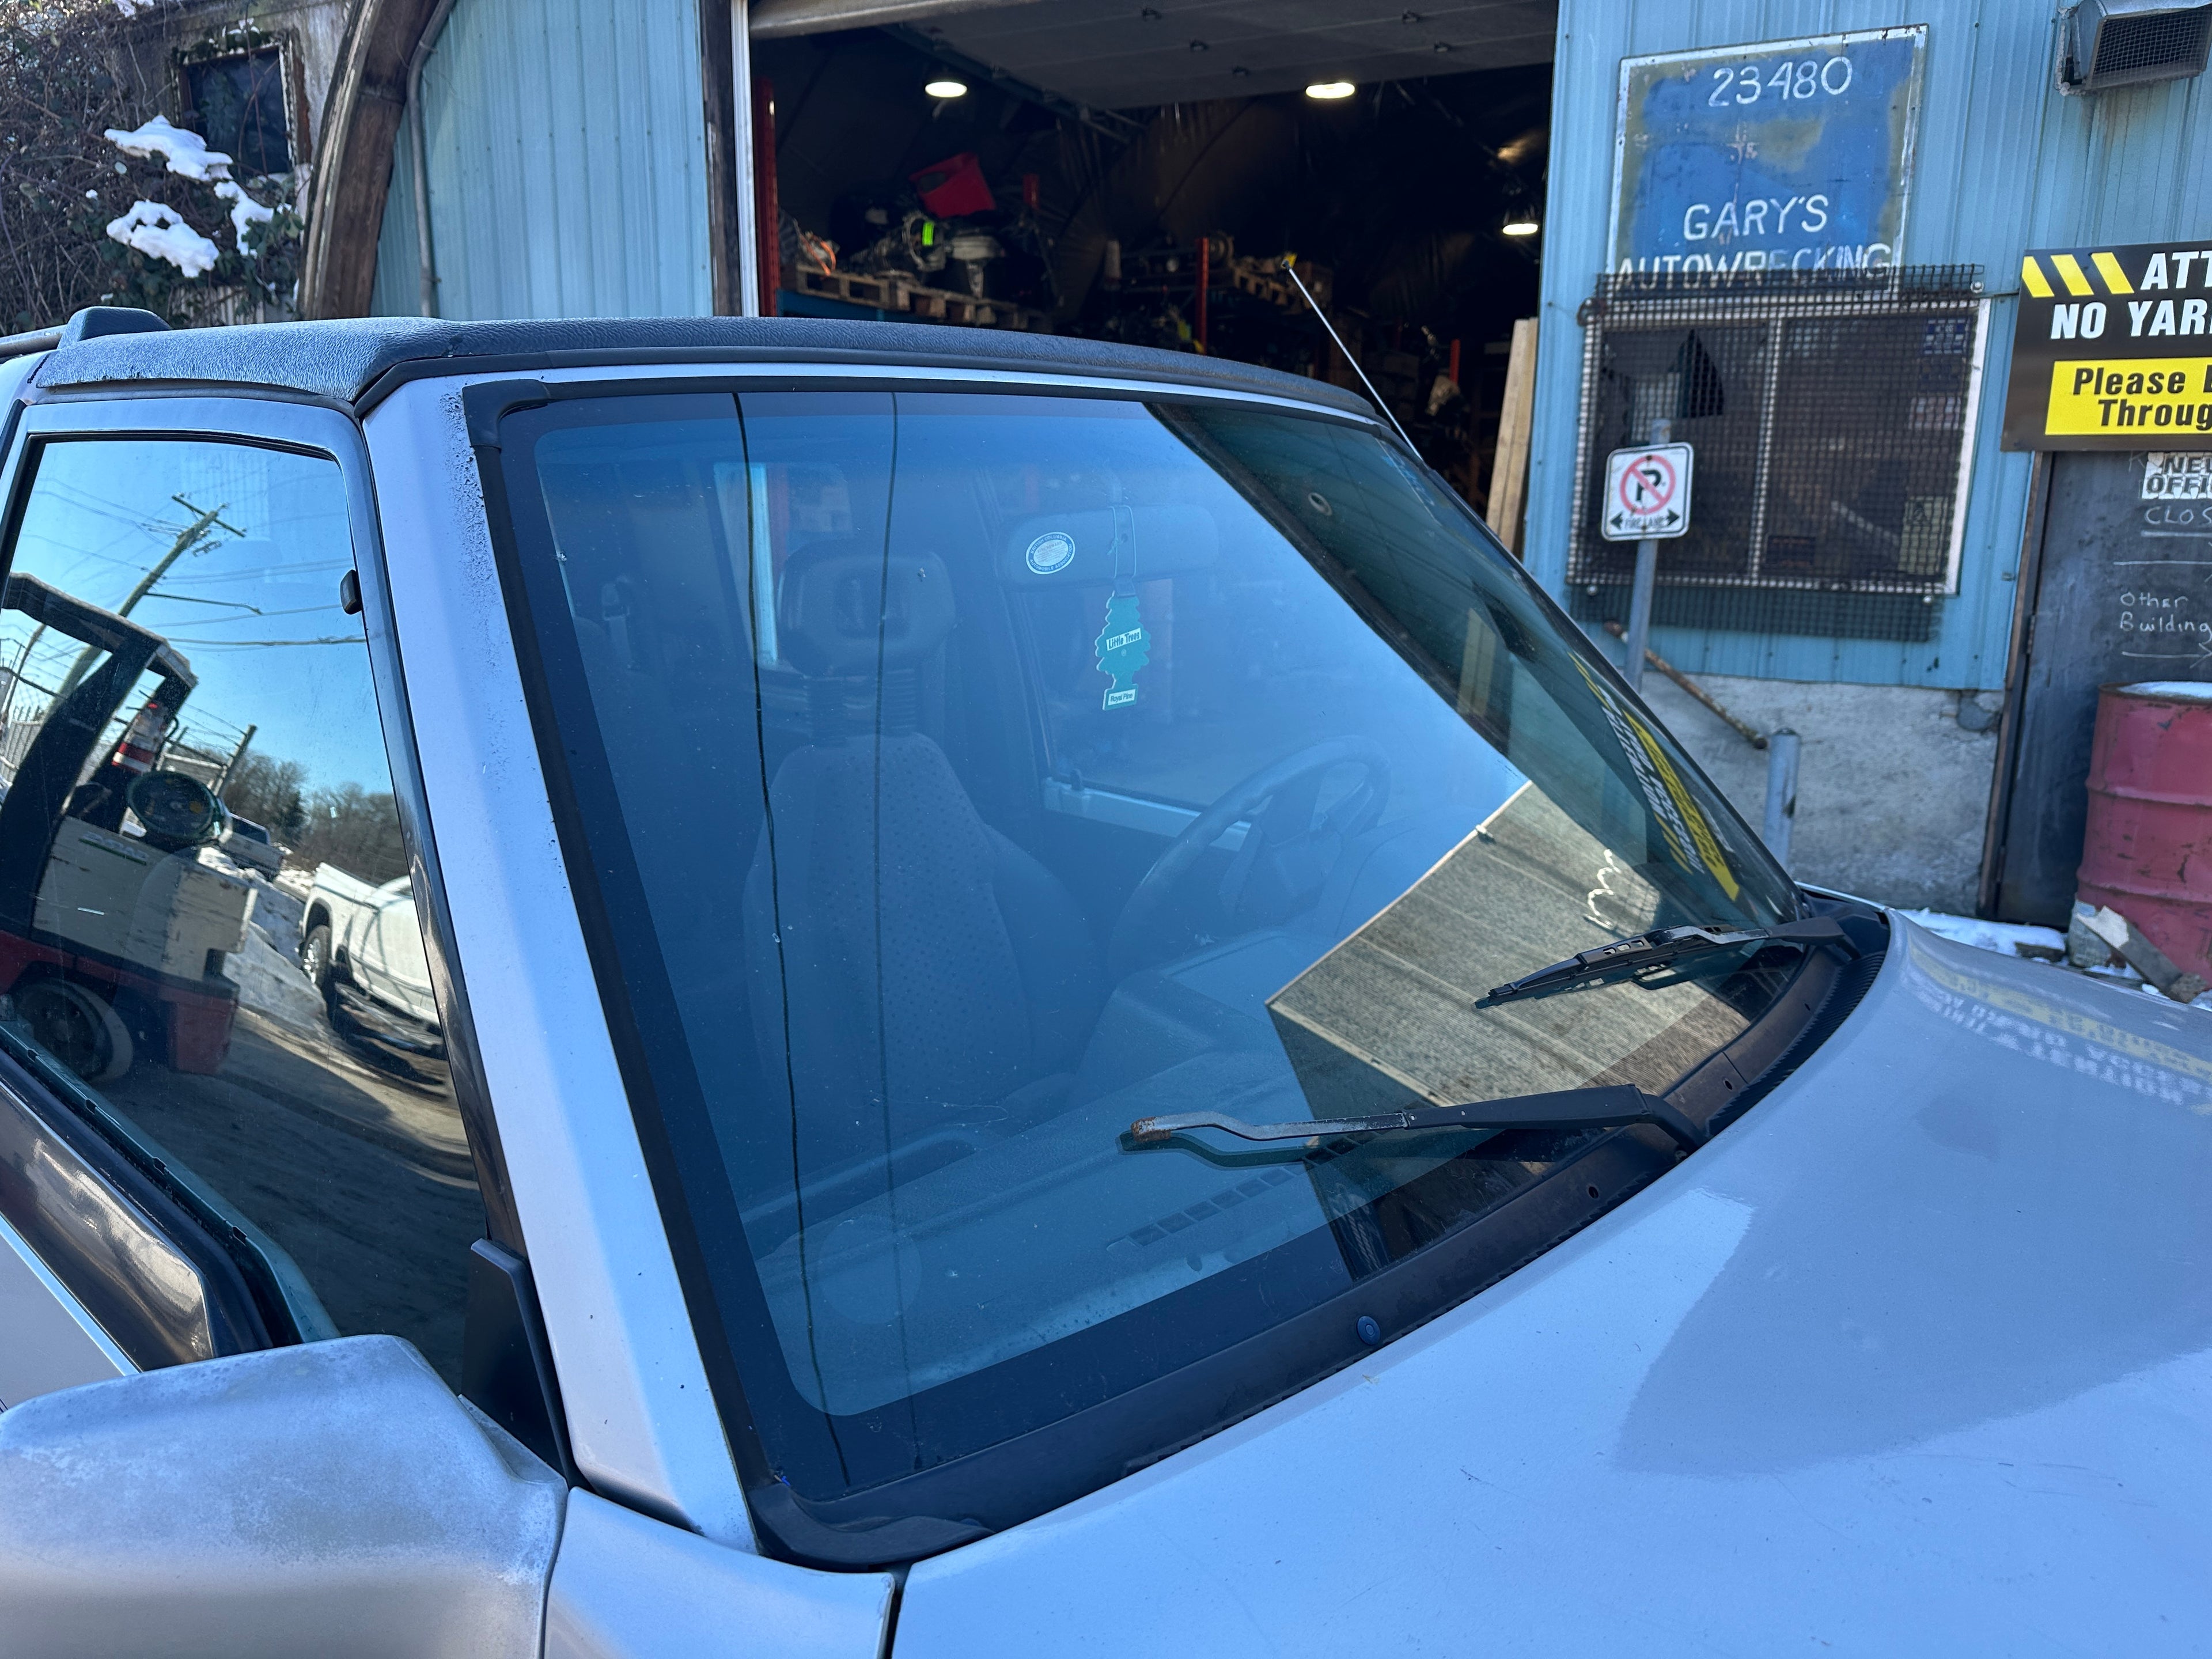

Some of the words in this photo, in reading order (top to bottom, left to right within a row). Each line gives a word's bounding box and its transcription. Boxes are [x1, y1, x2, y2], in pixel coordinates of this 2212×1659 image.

[1708, 56, 1853, 107] 23480
[1683, 195, 1828, 241] GARY'S
[2050, 302, 2107, 340] NO
[2128, 298, 2212, 337] YAR
[2073, 368, 2186, 395] Please
[2163, 456, 2212, 474] NE
[2146, 473, 2212, 494] OFFI
[2120, 592, 2188, 608] Other
[2120, 611, 2212, 645] Building
[1109, 636, 1124, 649] Little
[1124, 632, 1140, 643] Trees
[1110, 694, 1123, 703] Royal
